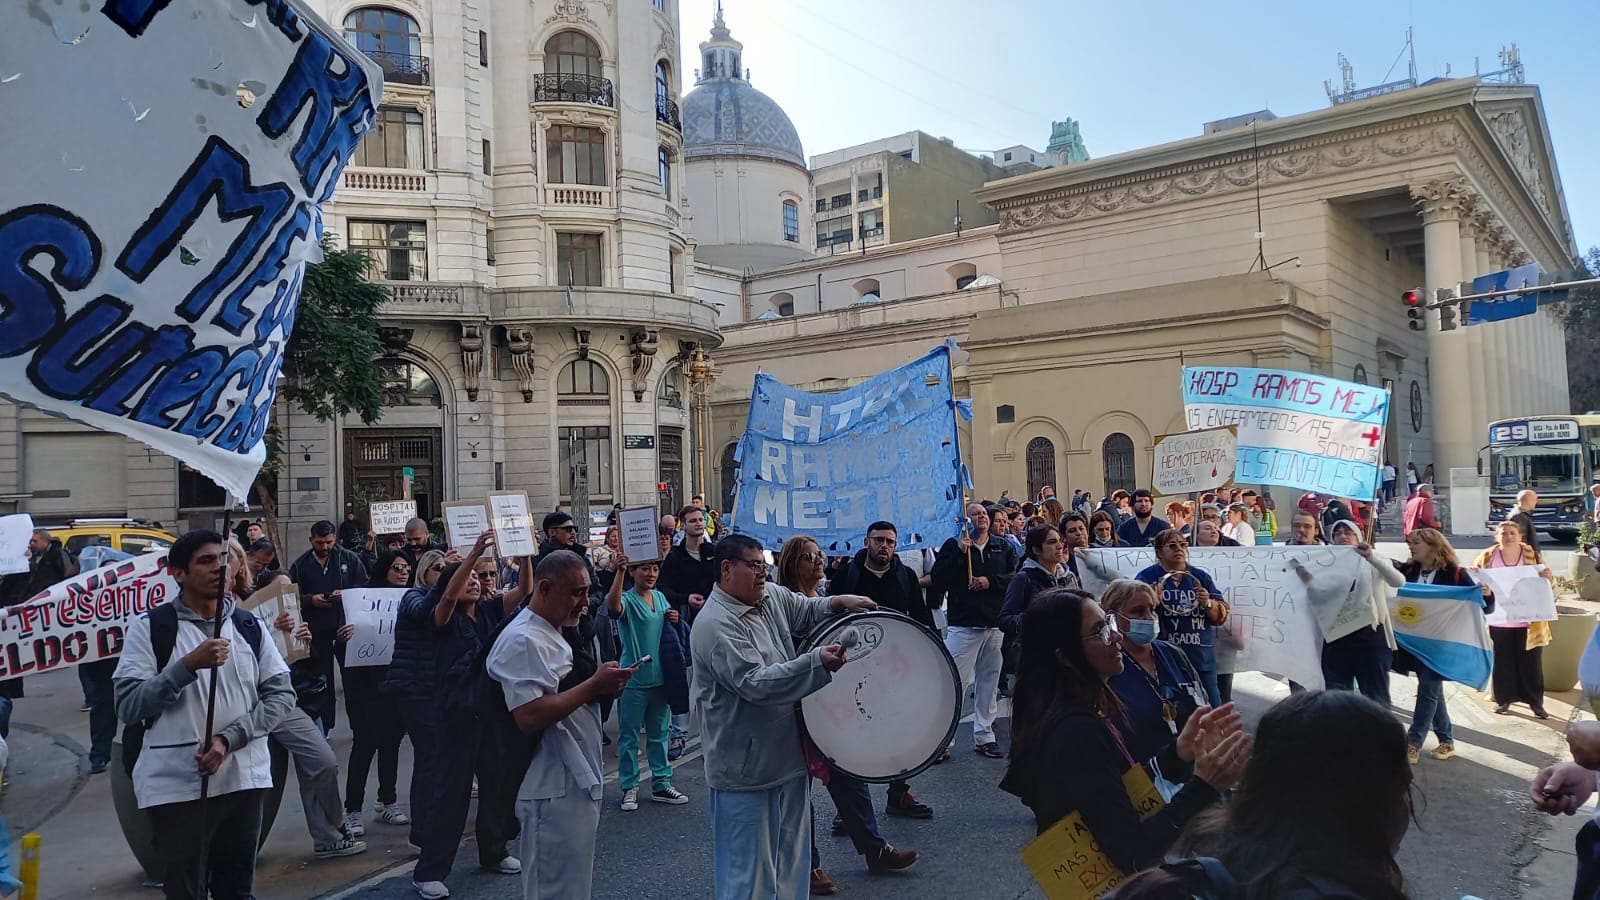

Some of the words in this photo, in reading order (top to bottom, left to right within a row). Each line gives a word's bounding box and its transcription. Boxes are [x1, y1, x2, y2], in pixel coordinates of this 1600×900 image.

[1189, 370, 1239, 396] HOSP
[1251, 373, 1327, 406] RAMOS
[1496, 425, 1528, 441] 29
[1161, 448, 1227, 469] HEMOTERAPIA
[1313, 440, 1378, 464] SOMOS
[372, 502, 415, 511] HOSPITAL
[19, 579, 166, 639] Presente
[1170, 618, 1179, 630] Y
[1053, 851, 1089, 880] MAS
